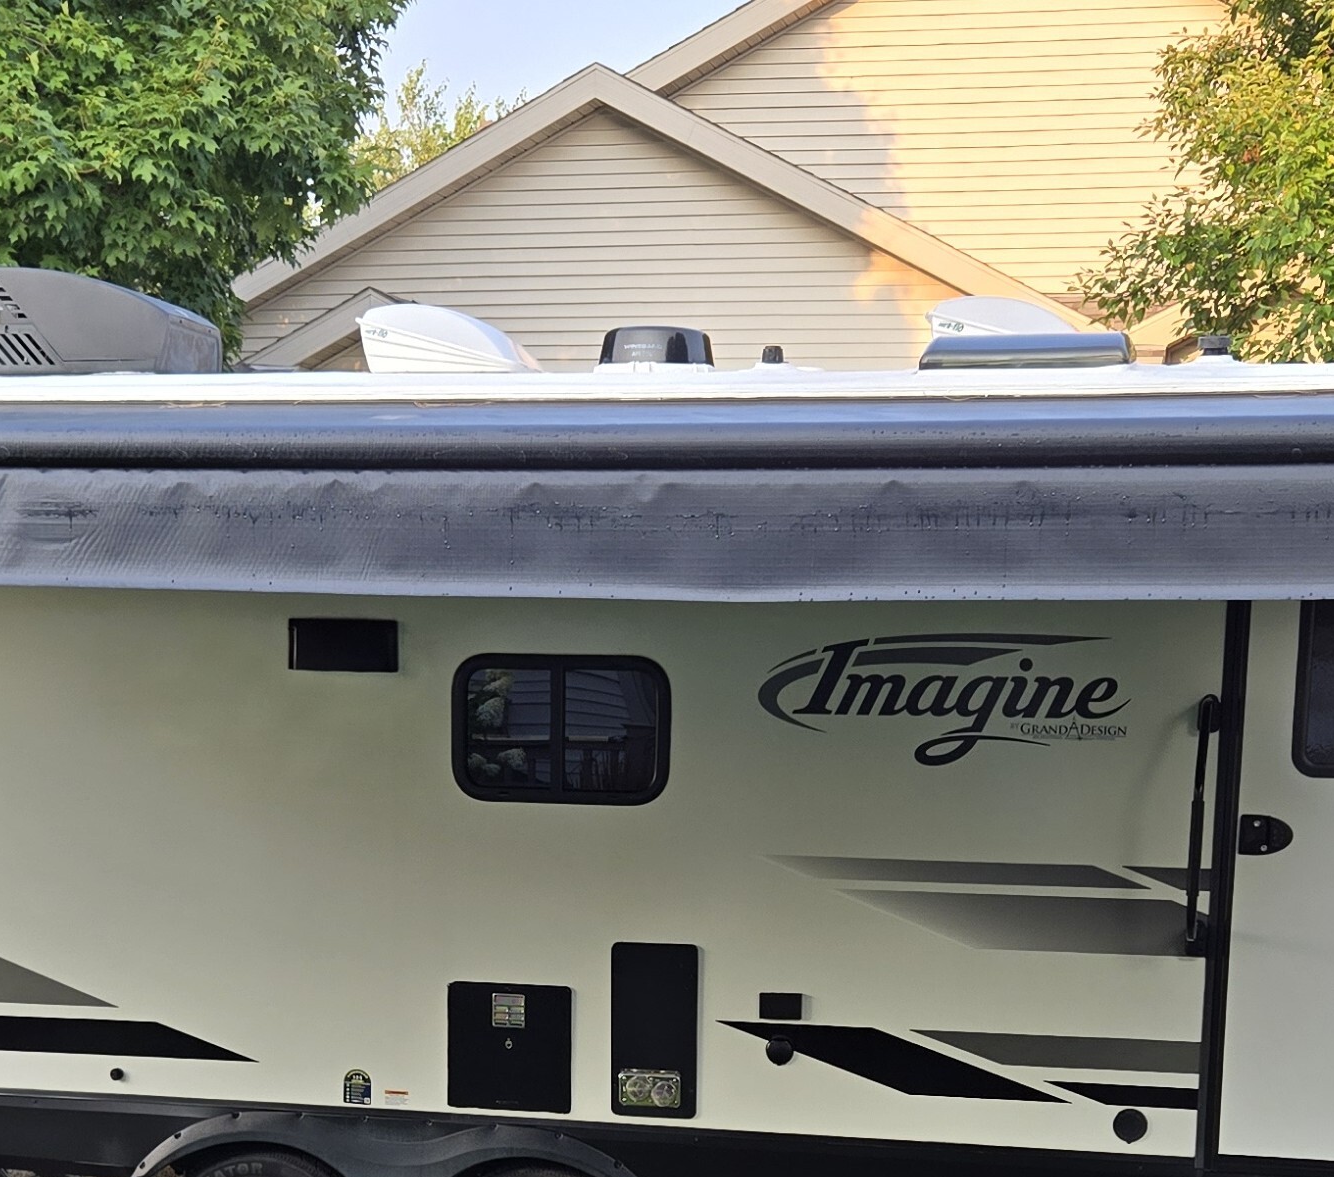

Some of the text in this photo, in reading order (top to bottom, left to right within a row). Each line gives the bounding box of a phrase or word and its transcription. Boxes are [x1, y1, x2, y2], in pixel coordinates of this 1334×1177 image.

[792, 637, 1132, 767] Imagine
[1020, 722, 1068, 736] GRAND
[1080, 723, 1128, 737] DESIGN
